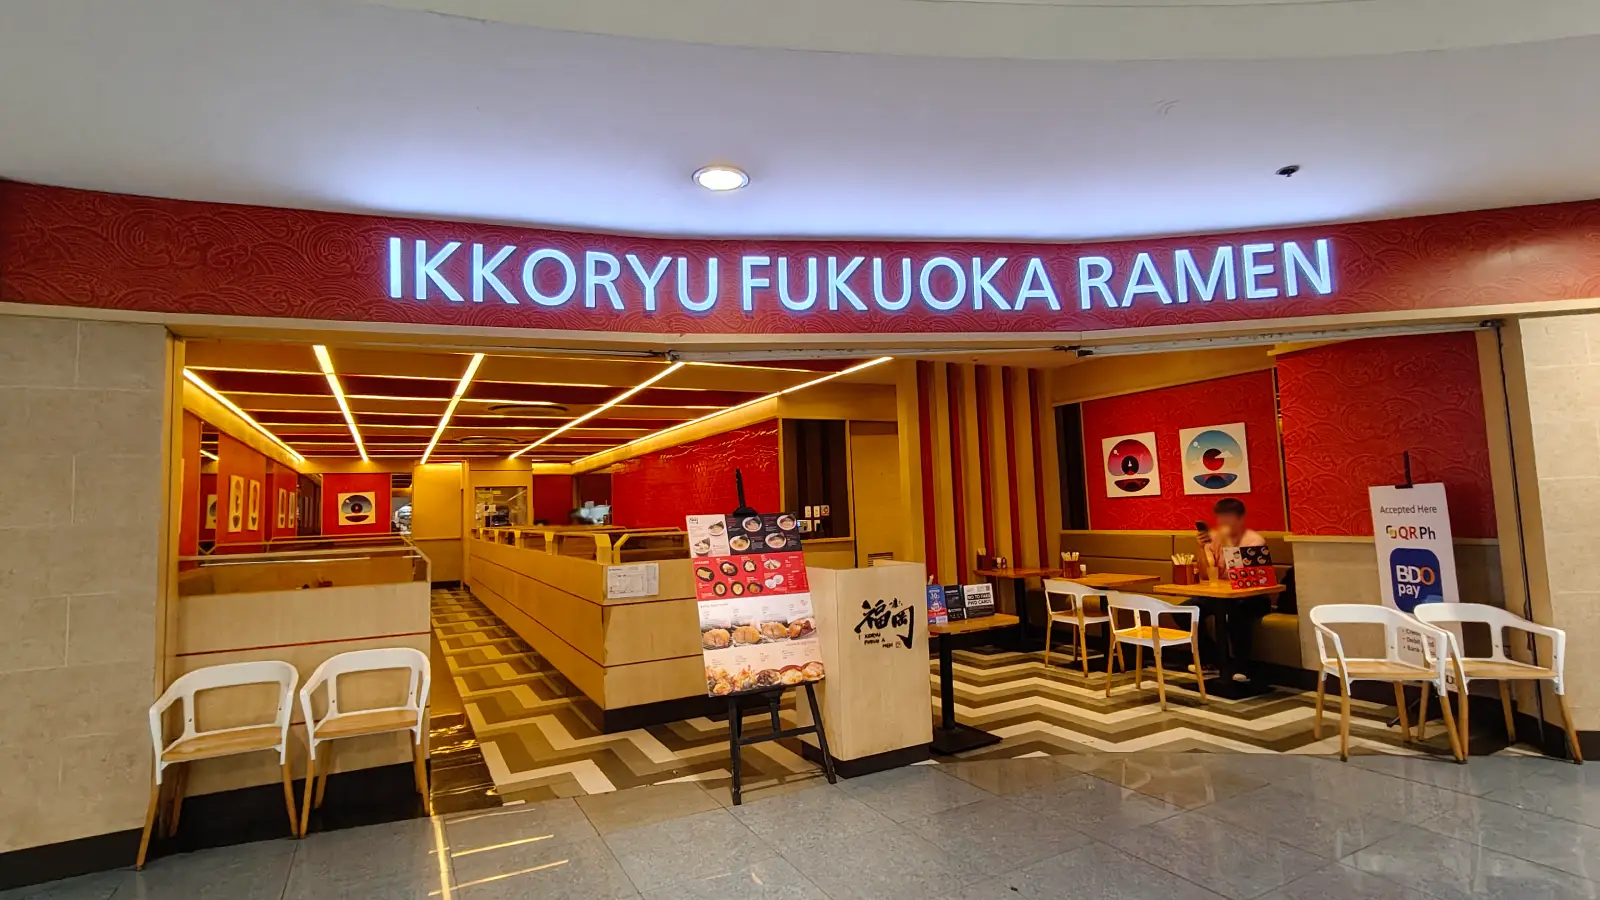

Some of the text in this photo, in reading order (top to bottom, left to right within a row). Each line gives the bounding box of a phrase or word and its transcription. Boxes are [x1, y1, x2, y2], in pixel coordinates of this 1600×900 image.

[388, 237, 1332, 311] IKKORYU FUKUOKA RAMEN
[1380, 504, 1437, 514] Accepted Here
[1396, 565, 1435, 586] BDO
[1398, 583, 1420, 599] pay
